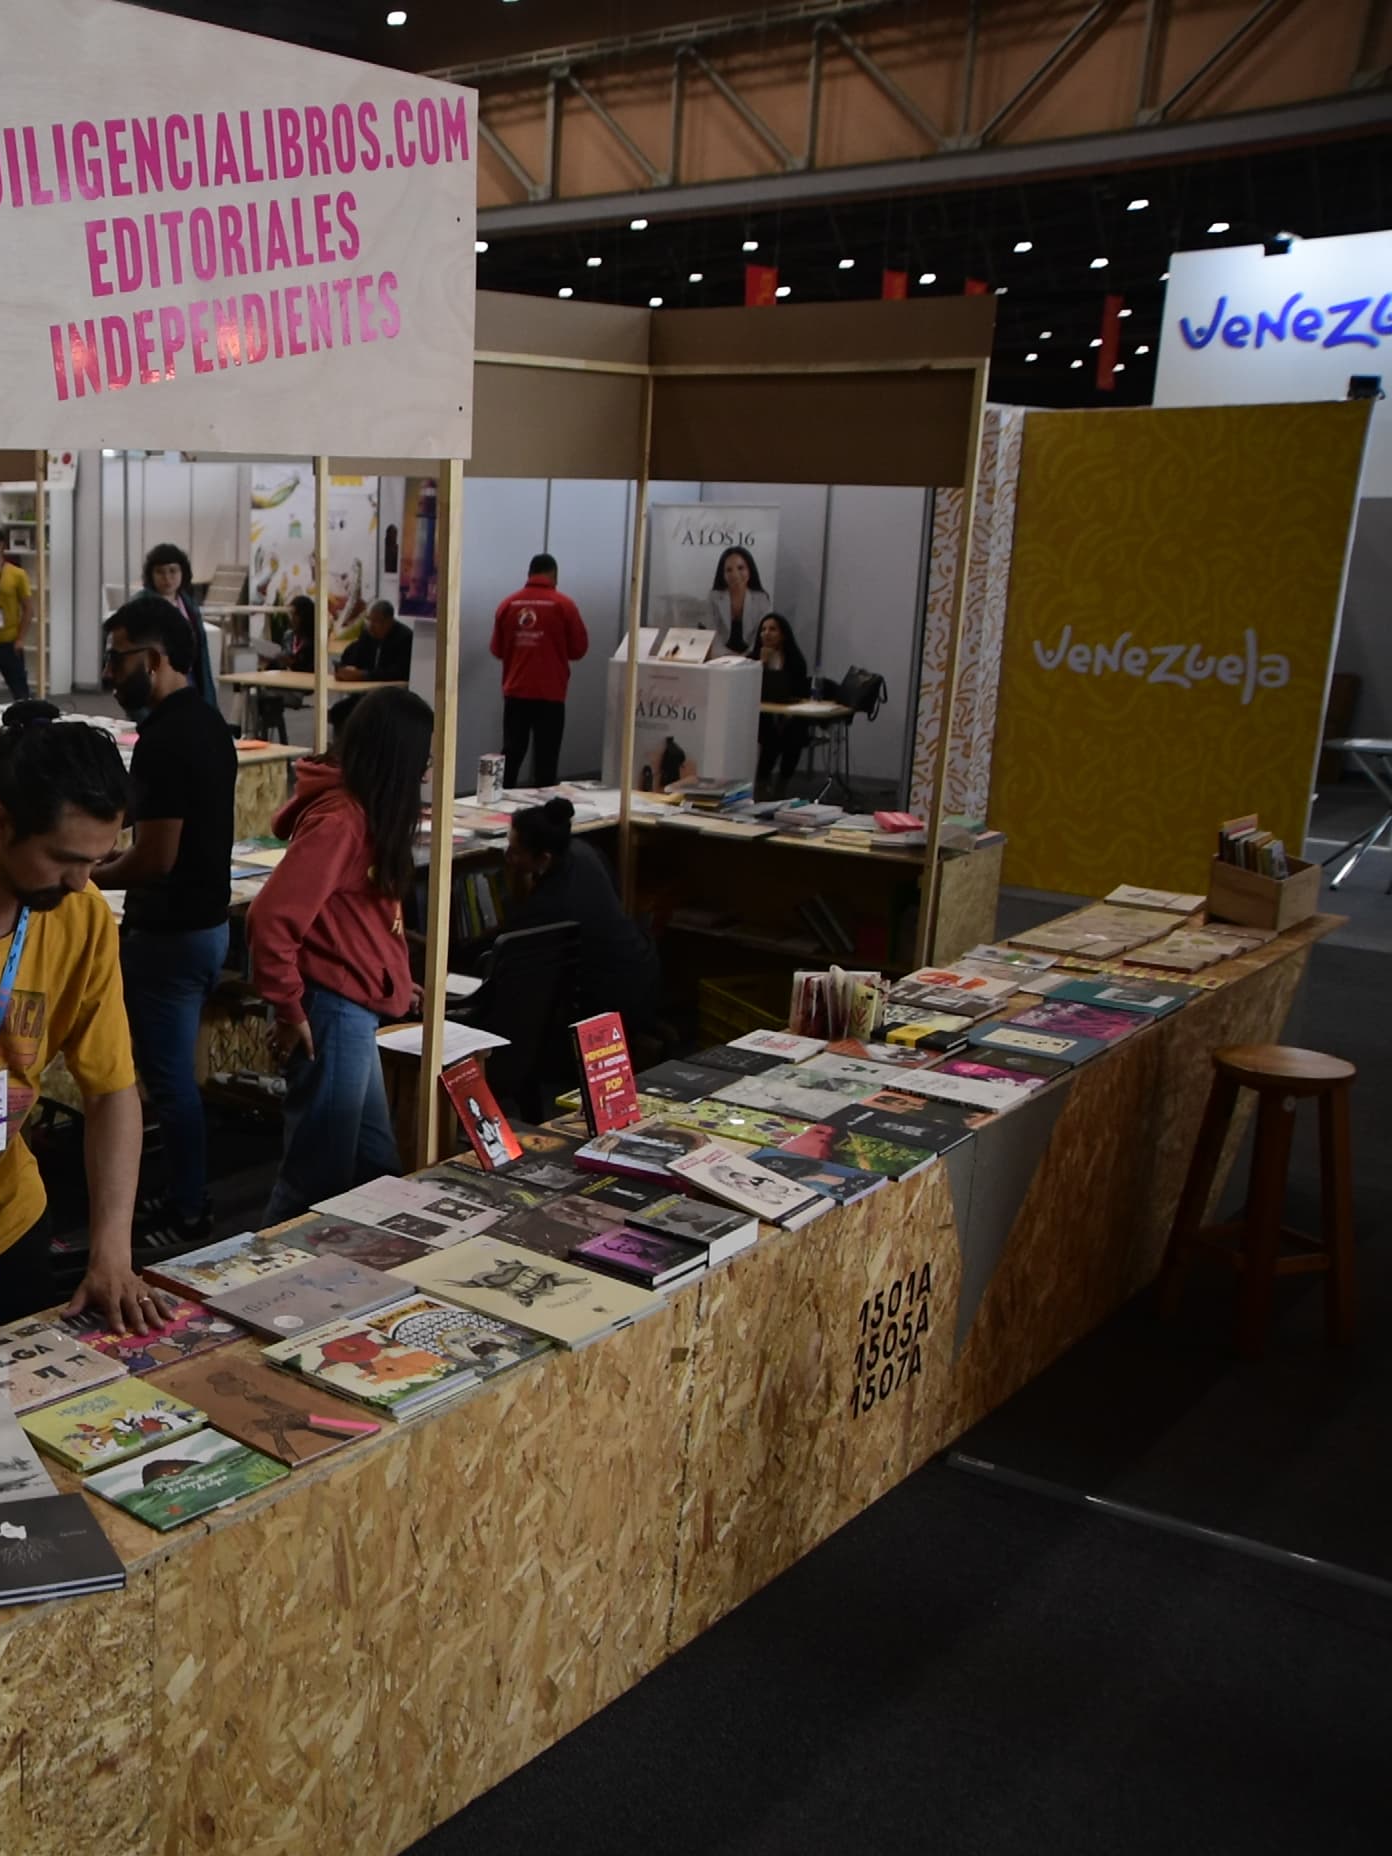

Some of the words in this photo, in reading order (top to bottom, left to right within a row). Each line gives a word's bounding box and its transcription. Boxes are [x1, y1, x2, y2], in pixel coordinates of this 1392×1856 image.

[85, 191, 361, 297] EDITORIALES
[49, 271, 401, 401] INDEPENDIENTES
[681, 530, 695, 546] A
[698, 530, 734, 547] LOS
[737, 531, 756, 547] 16
[682, 706, 697, 721] 16
[605, 1077, 624, 1092] POP
[858, 1262, 931, 1336] 1501A
[854, 1302, 928, 1377] 1505A
[850, 1344, 921, 1419] 1507A
